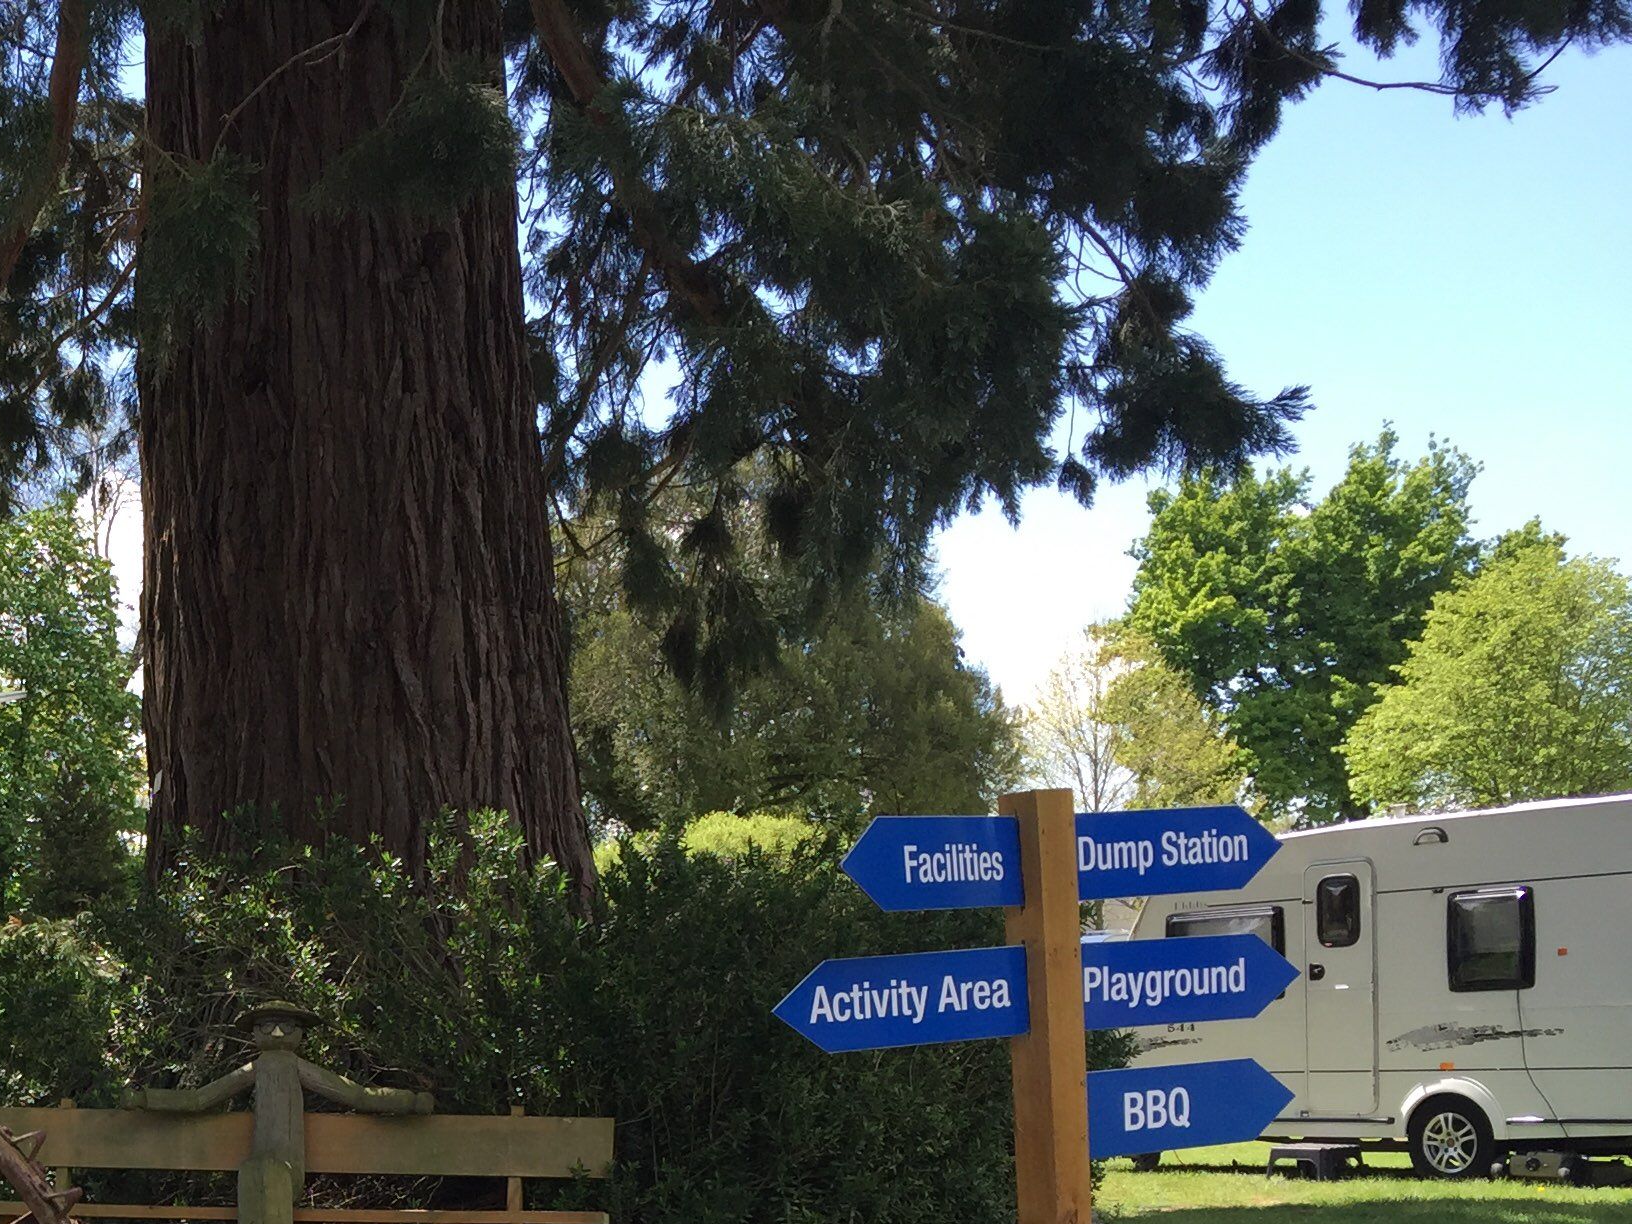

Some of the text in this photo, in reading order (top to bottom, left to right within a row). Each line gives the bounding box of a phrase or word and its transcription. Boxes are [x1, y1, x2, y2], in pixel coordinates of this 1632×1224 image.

[903, 843, 1004, 884] Facilities
[1077, 829, 1249, 876] Dump Station
[809, 975, 1012, 1024] Activity Area
[1083, 957, 1247, 1008] Playground
[1123, 1086, 1192, 1132] BBQ
